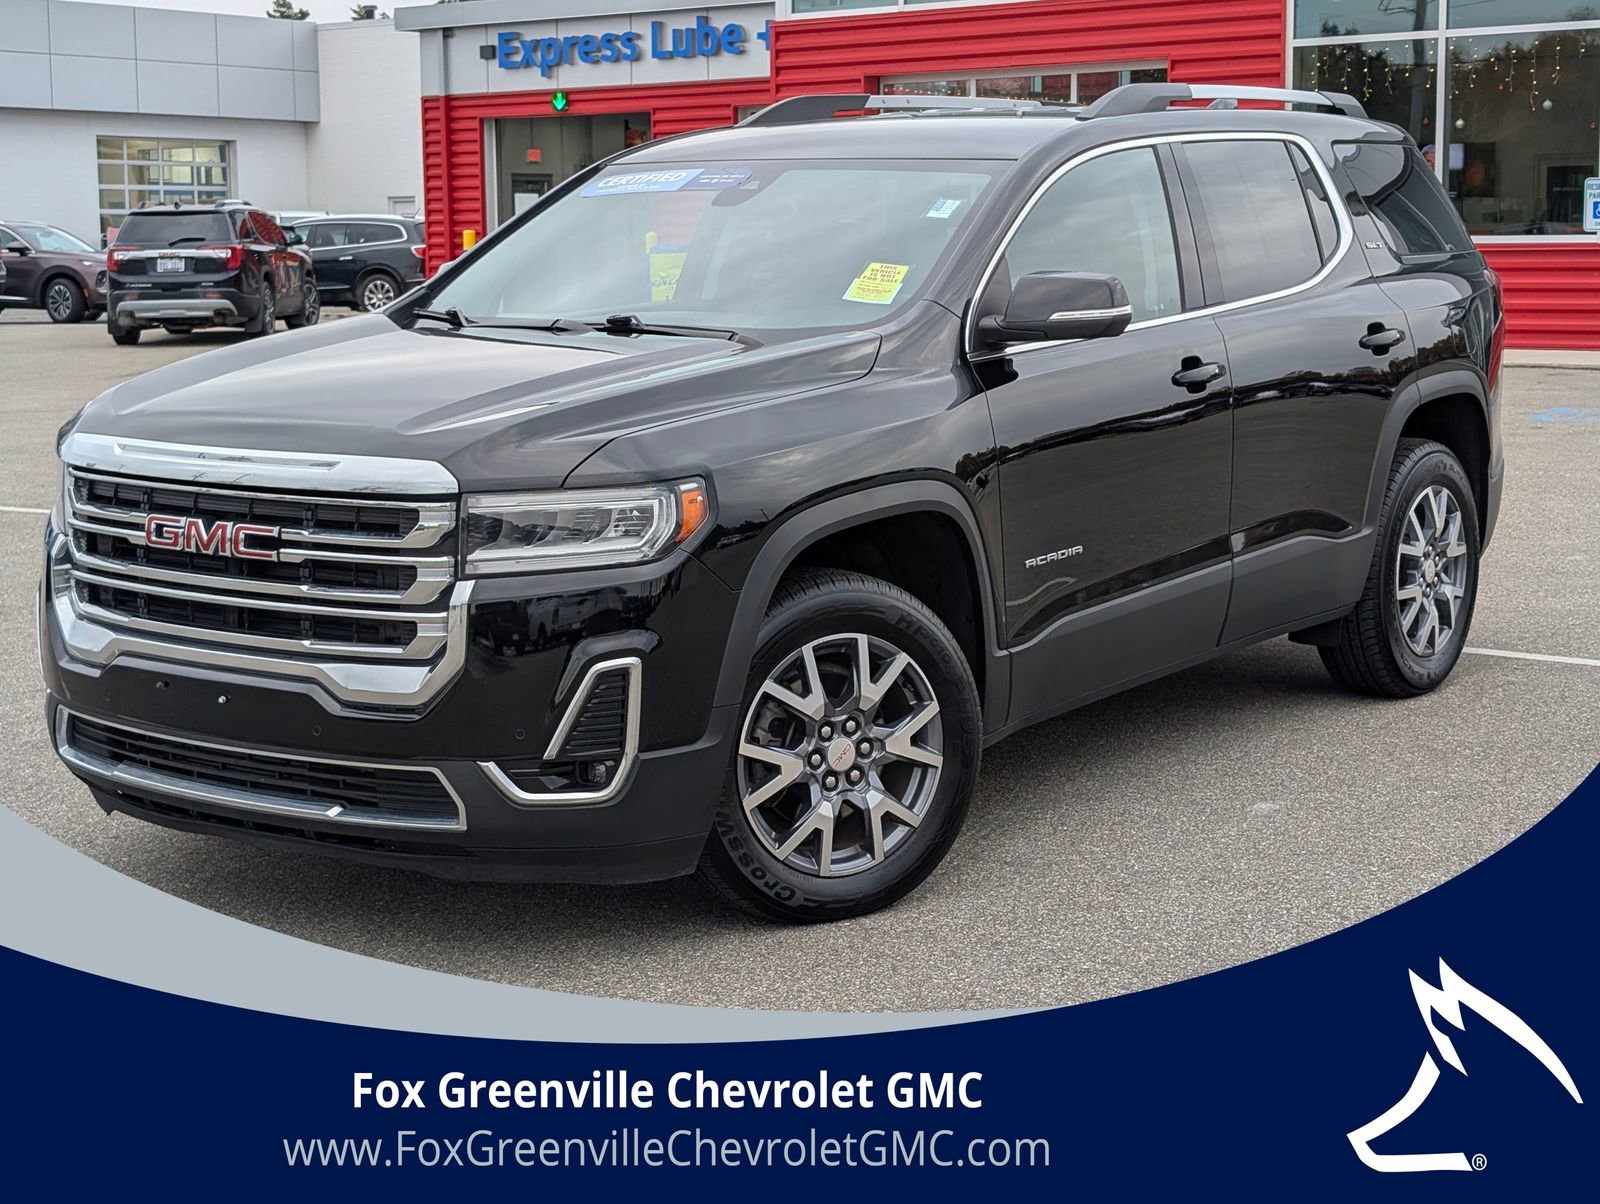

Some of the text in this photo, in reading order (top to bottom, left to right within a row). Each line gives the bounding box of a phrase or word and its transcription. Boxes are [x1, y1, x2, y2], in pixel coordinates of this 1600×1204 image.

[498, 31, 640, 78] Express
[651, 16, 746, 59] Lube
[598, 171, 688, 188] CERTIFIED
[1365, 241, 1382, 249] SLT
[145, 513, 280, 562] GMC
[1025, 545, 1083, 569] ACADIA
[831, 742, 852, 768] GMC
